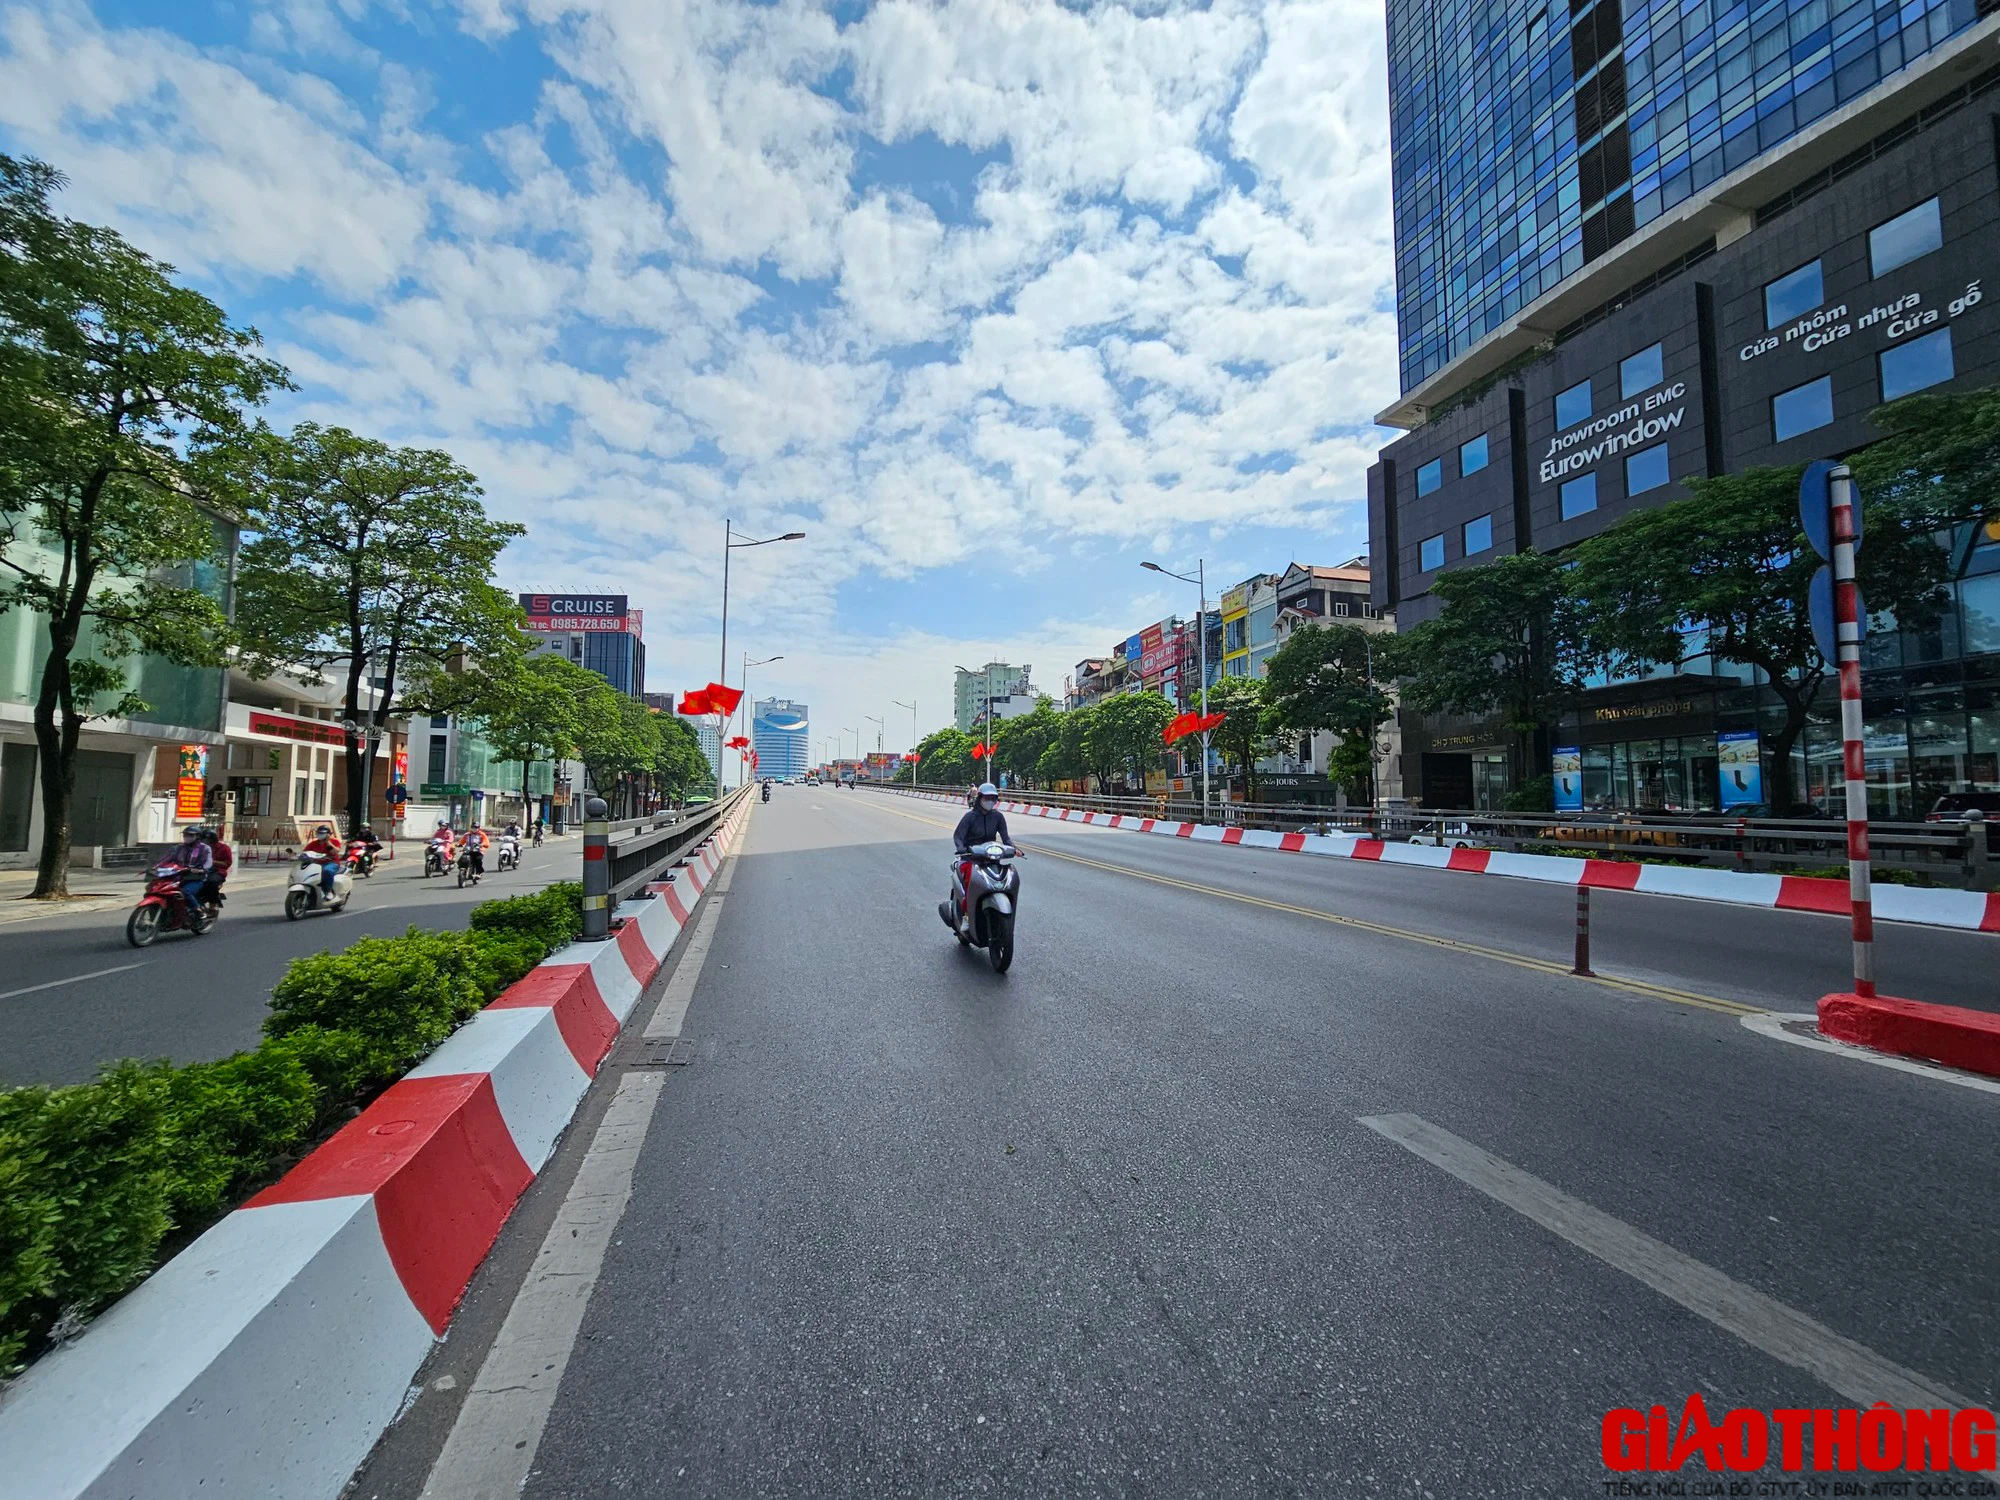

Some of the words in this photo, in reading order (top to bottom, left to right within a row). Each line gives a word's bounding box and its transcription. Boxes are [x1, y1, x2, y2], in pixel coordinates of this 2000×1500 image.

[1803, 322, 1851, 352] Cửa
[1858, 292, 1921, 329] nhựa
[1887, 309, 1939, 339] Cửa
[1948, 279, 1983, 318] gỗ
[1740, 335, 1779, 361] Cửa
[1785, 304, 1847, 341] nhôm
[1645, 382, 1687, 412] EMC
[1539, 407, 1685, 484] Eurowindow
[551, 619, 620, 629] 0985.728.650
[1595, 708, 1620, 720] Khu
[1449, 735, 1475, 745] TRUNG
[1276, 778, 1298, 786] JOURS
